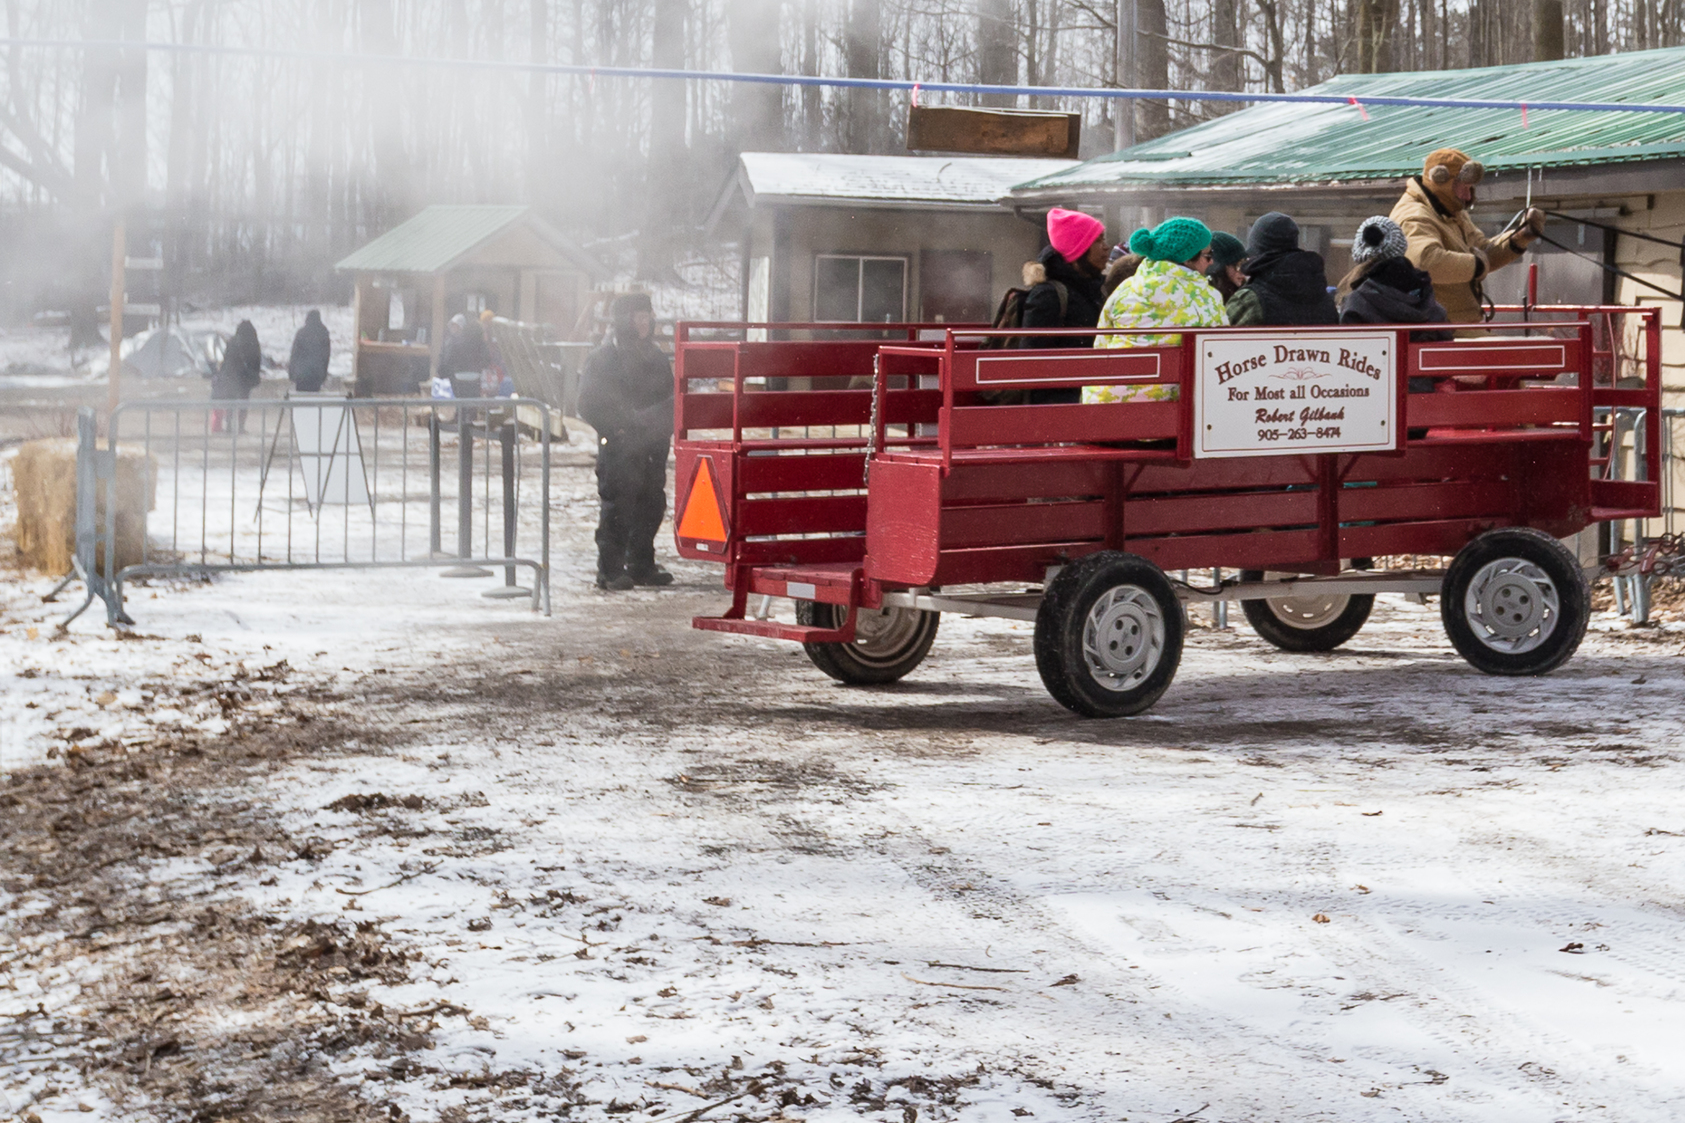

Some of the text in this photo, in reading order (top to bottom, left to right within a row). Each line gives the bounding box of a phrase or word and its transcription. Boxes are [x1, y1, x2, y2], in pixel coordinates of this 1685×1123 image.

[1215, 345, 1382, 384] Horse Drawn Rides
[1227, 384, 1370, 401] For Most all Occasions
[1255, 406, 1345, 426] Robert Gilbank
[1257, 427, 1341, 441] 905-263-8474
